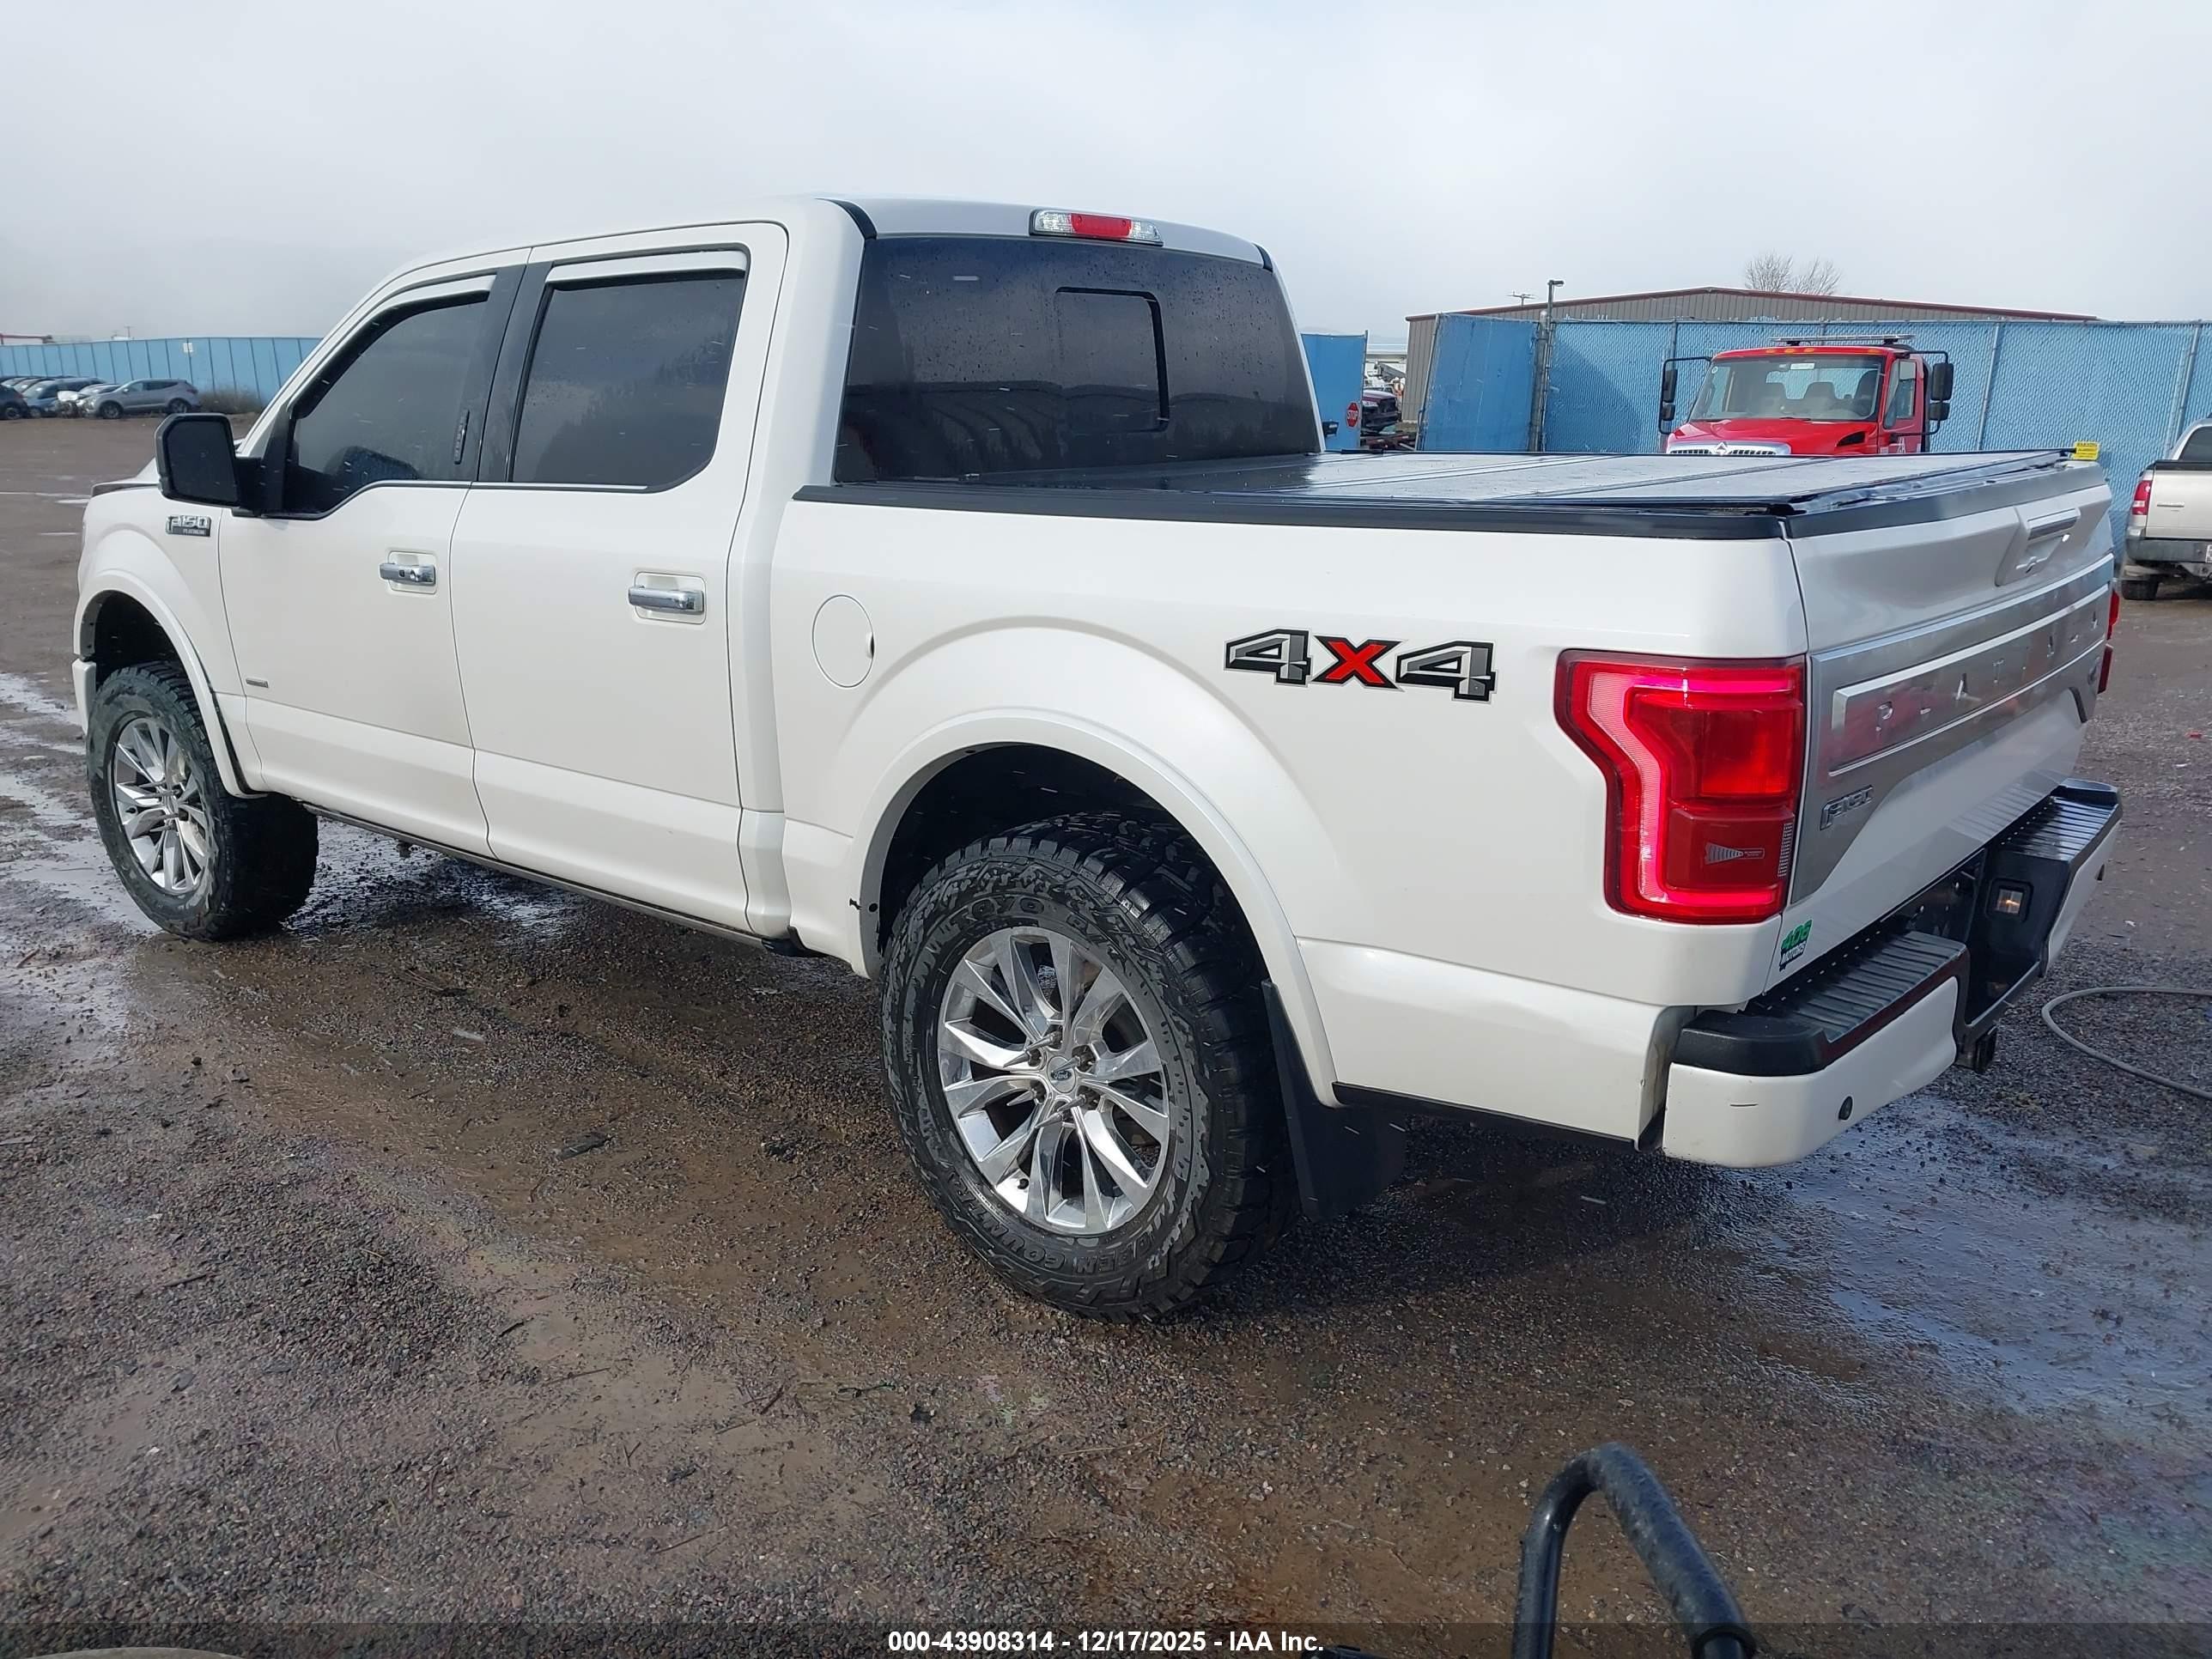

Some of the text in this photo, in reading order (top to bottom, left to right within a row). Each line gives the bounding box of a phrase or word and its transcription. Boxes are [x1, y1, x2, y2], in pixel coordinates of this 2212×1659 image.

[1346, 410, 1358, 421] STOP
[949, 895, 1045, 933] TOYO
[1781, 920, 1812, 950] 406
[1780, 940, 1806, 964] MOTORS
